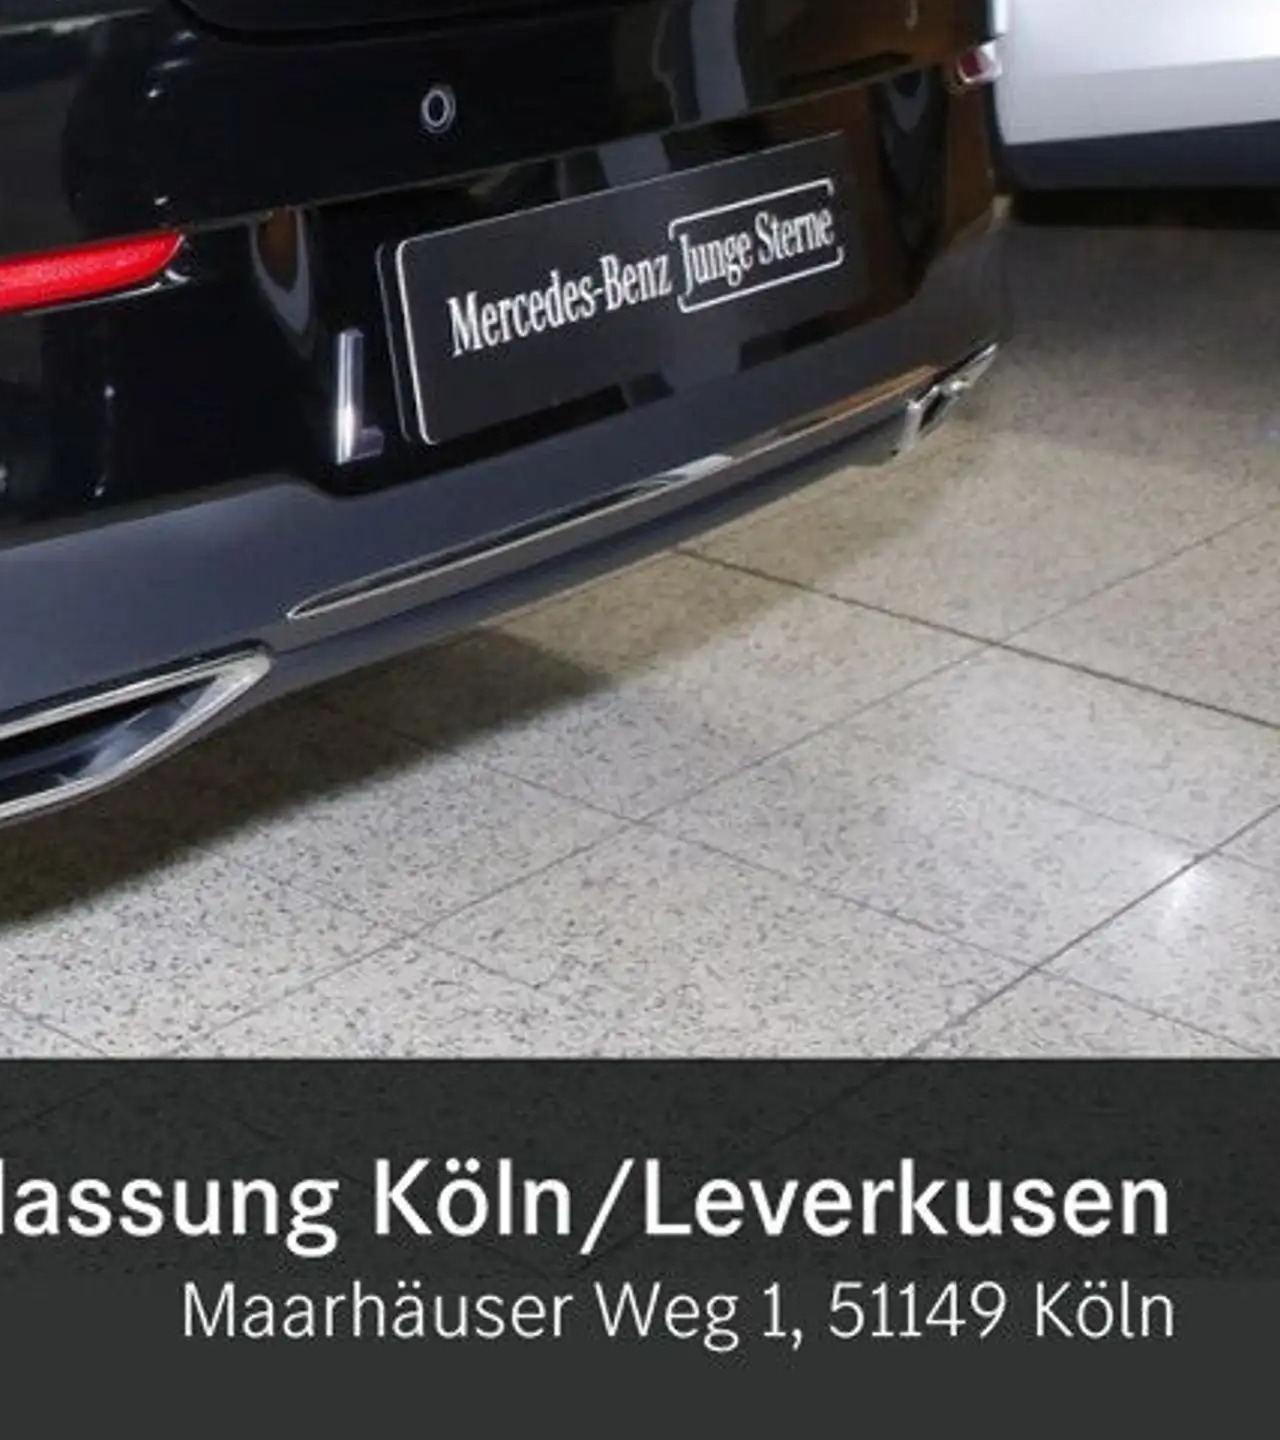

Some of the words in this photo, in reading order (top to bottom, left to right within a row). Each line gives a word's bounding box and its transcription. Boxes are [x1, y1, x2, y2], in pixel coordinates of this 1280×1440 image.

[446, 253, 673, 358] Mercedes-Benz
[678, 232, 754, 296] Junge
[755, 208, 835, 267] Sterne
